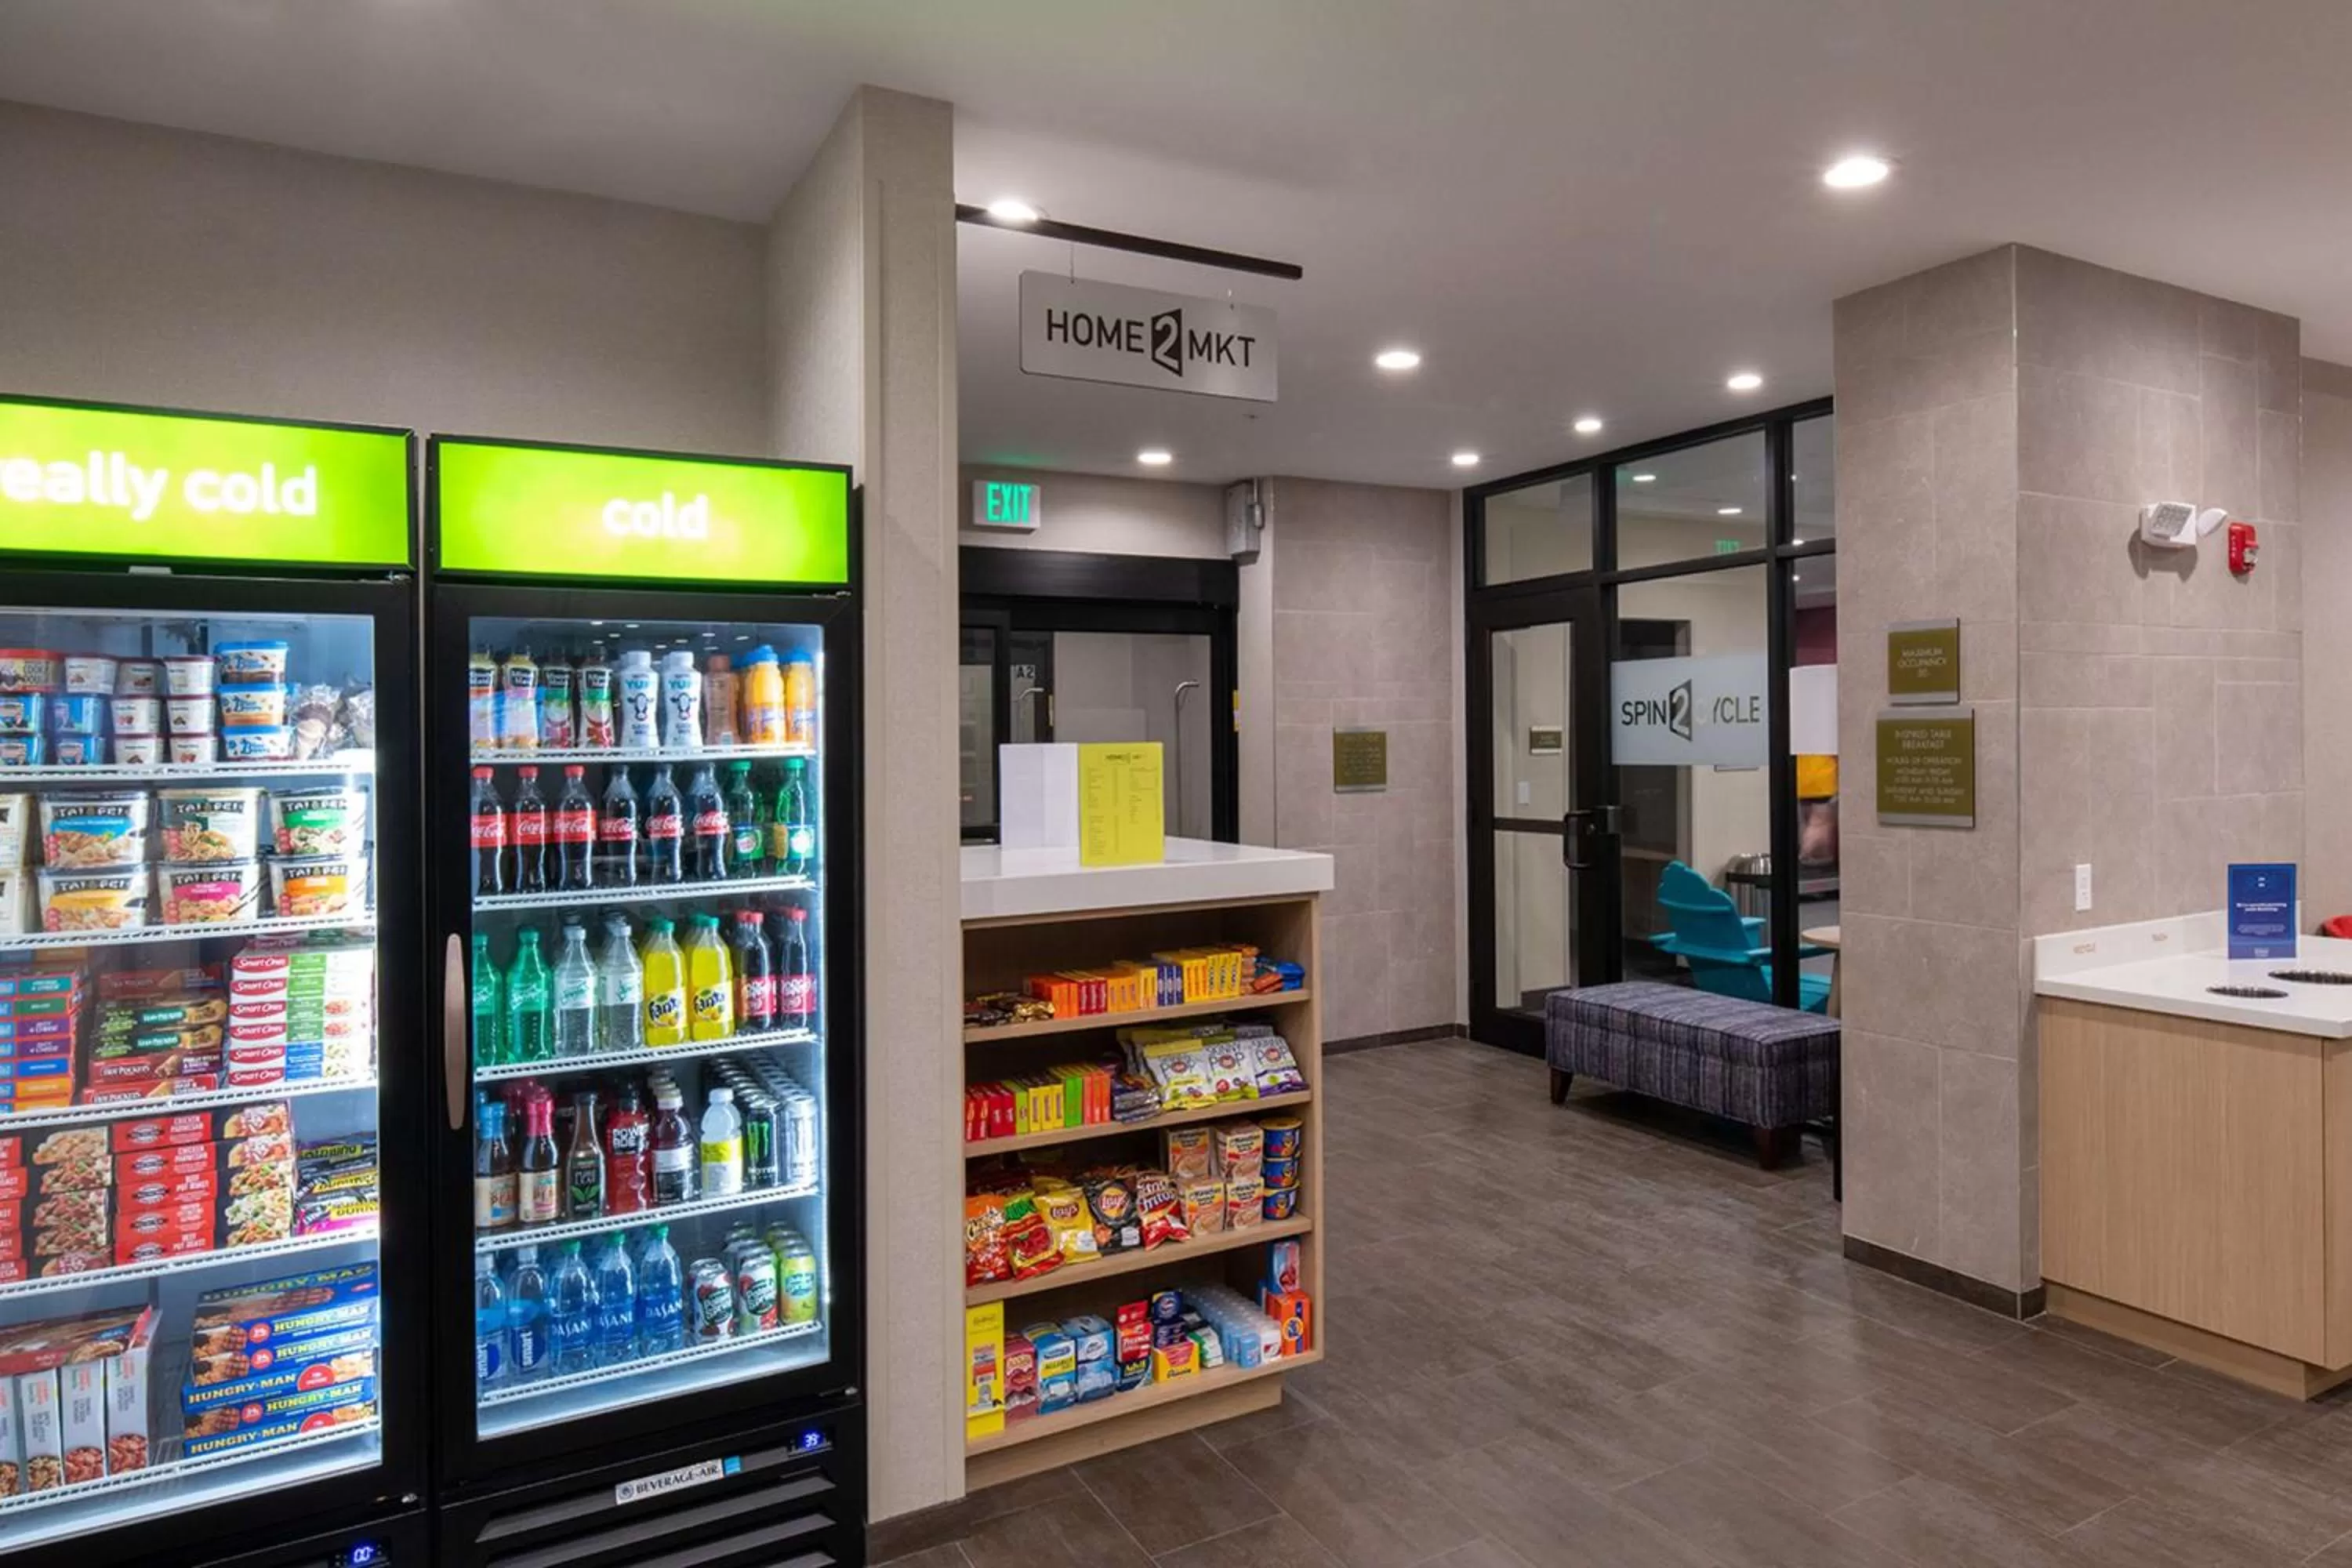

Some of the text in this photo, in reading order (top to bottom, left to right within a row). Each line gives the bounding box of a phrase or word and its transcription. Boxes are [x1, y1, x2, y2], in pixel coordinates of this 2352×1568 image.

[0, 450, 318, 521] eally cold
[986, 482, 1032, 524] EXIT
[602, 491, 710, 539] cold
[648, 996, 680, 1021] Fant
[635, 1465, 719, 1494] BEVERAGE-AIR
